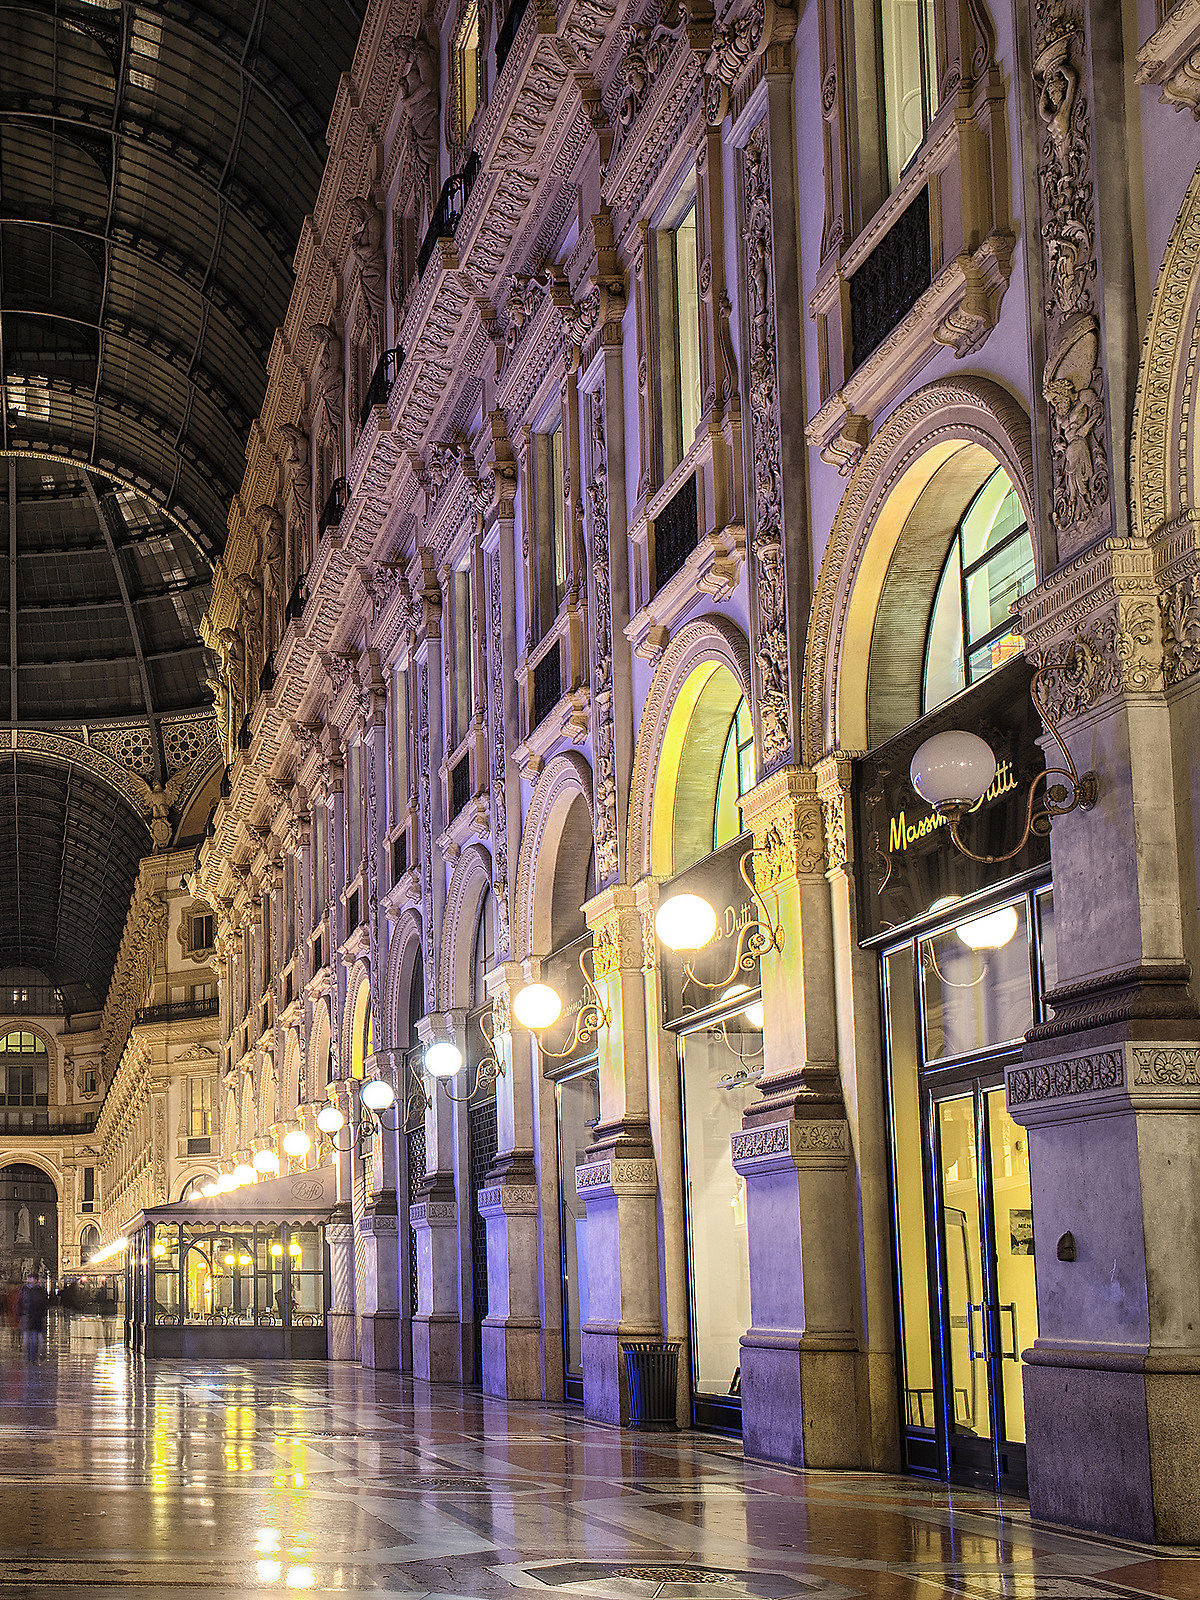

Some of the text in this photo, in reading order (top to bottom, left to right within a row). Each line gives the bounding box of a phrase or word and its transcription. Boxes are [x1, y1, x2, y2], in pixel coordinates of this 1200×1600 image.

[889, 811, 949, 853] Massim
[723, 902, 752, 938] Dutti
[294, 1181, 321, 1200] Biffi
